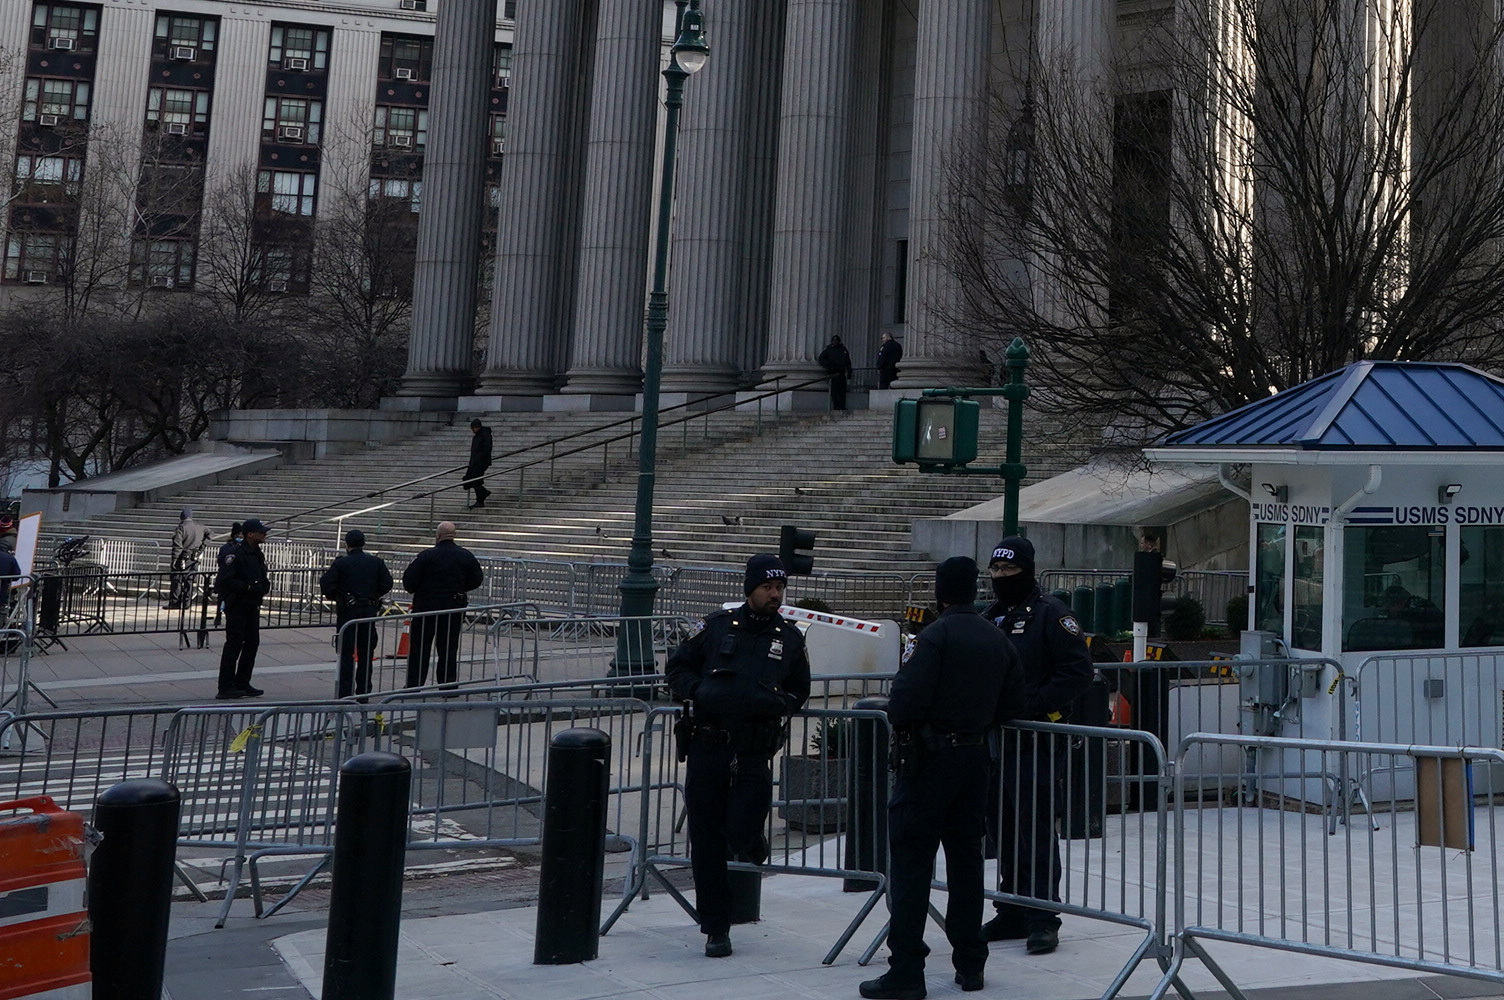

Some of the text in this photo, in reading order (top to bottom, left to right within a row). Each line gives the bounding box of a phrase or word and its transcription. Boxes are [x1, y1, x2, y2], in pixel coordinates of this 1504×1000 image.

[1260, 503, 1321, 524] USMS SDNY
[1395, 506, 1504, 524] USMS SDNY
